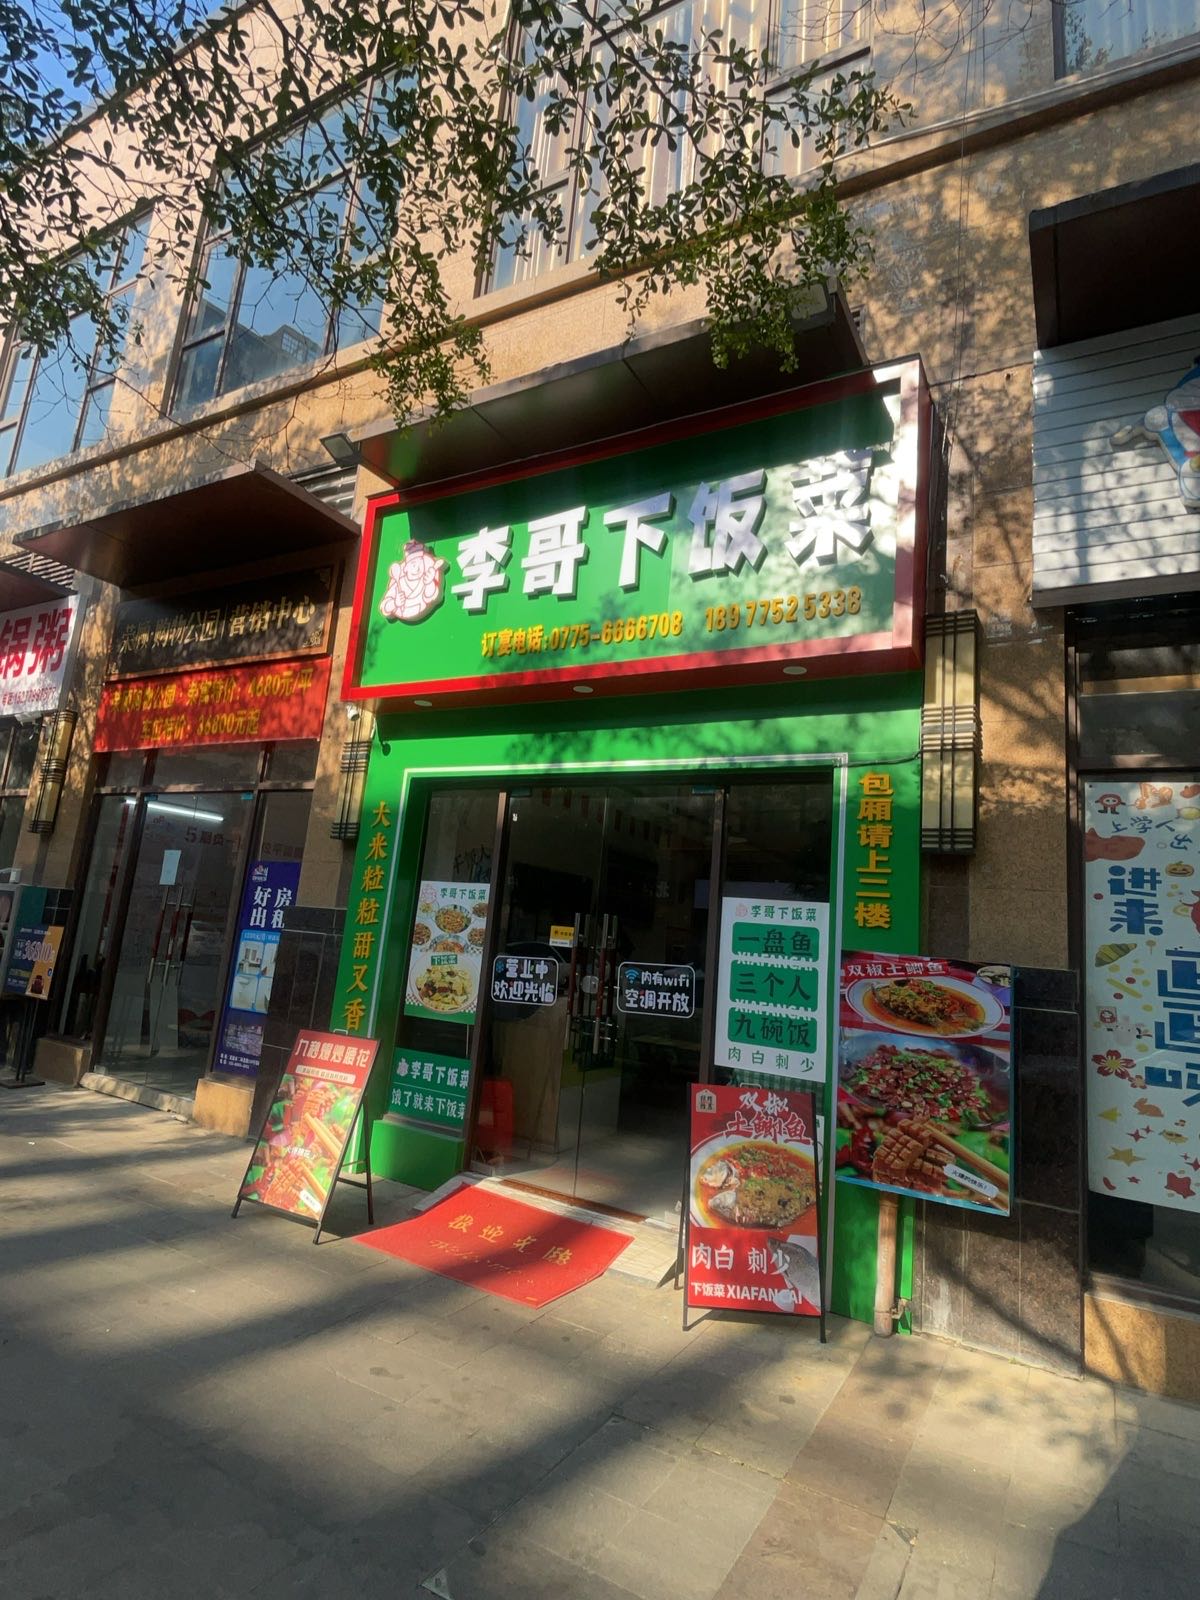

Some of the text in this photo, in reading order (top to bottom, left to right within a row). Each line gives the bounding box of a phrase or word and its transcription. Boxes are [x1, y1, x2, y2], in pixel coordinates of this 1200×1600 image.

[451, 449, 878, 613] 李哥下饭菜
[854, 772, 894, 929] 包厢请上二楼
[254, 886, 292, 909] 好房
[440, 887, 487, 901] 李哥下饭菜
[250, 908, 285, 930] 出租
[343, 800, 392, 1031] 大米粒粒甜又香
[751, 905, 817, 922] 李哥下饭菜
[738, 929, 813, 957] 一盘鱼
[505, 958, 549, 979] 营业中
[494, 980, 555, 1004] 欢迎光临
[736, 972, 811, 1001] 三个人
[625, 988, 690, 1013] 空调开放
[734, 1014, 811, 1047] 九碗饭
[411, 1061, 470, 1089] 李哥下饭菜
[739, 1092, 790, 1115] 双椒
[724, 1111, 813, 1144] 土鲫鱼
[691, 1281, 725, 1298] 下饭菜
